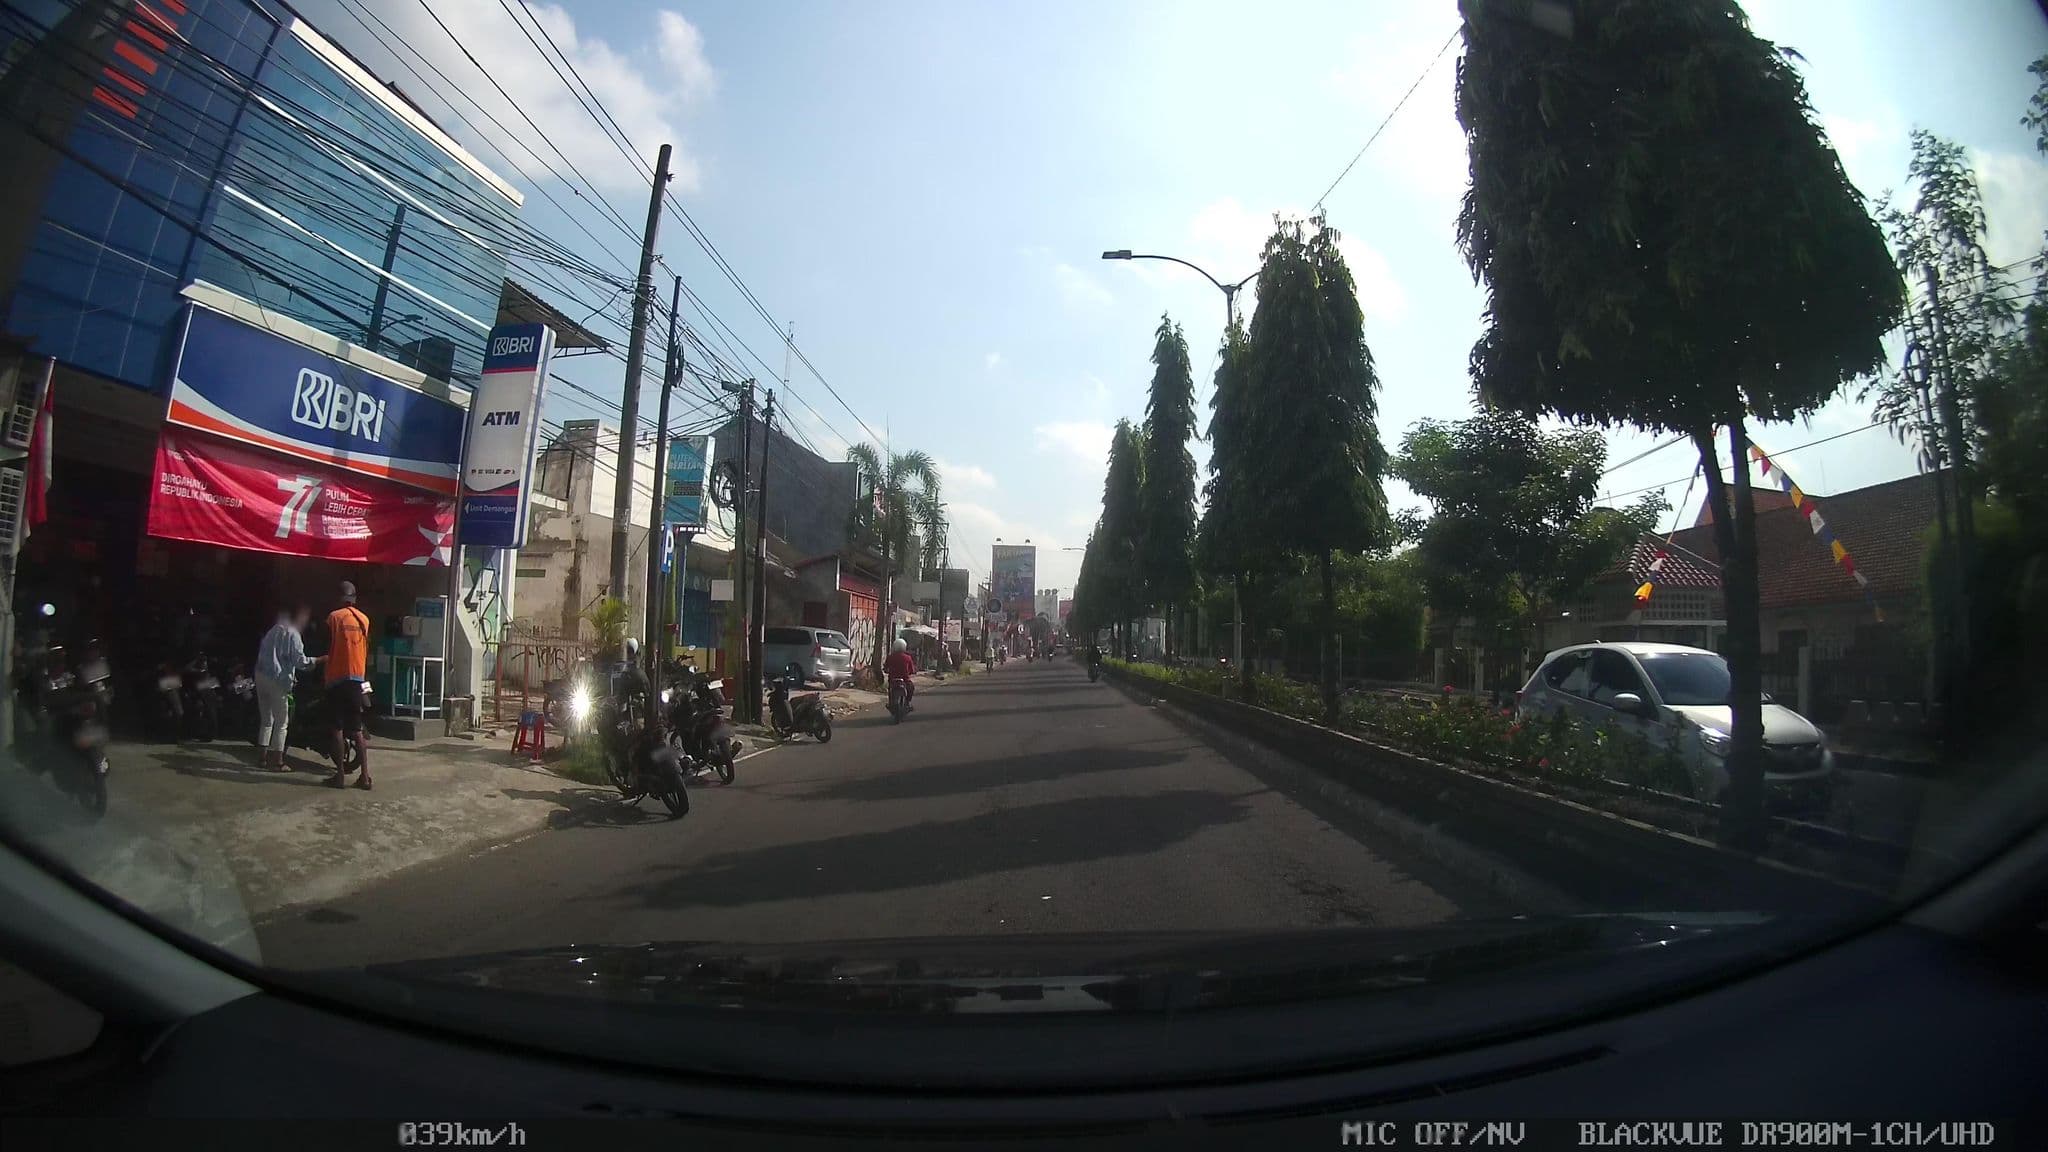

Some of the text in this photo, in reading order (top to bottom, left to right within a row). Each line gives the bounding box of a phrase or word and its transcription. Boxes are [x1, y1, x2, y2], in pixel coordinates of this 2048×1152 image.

[508, 336, 535, 354] BRI
[328, 384, 386, 443] BRI
[482, 410, 521, 426] ATM
[161, 472, 208, 490] DIRGAHAYU
[160, 483, 243, 509] REPUBLIK INDONESIA
[324, 502, 346, 515] LEBIH
